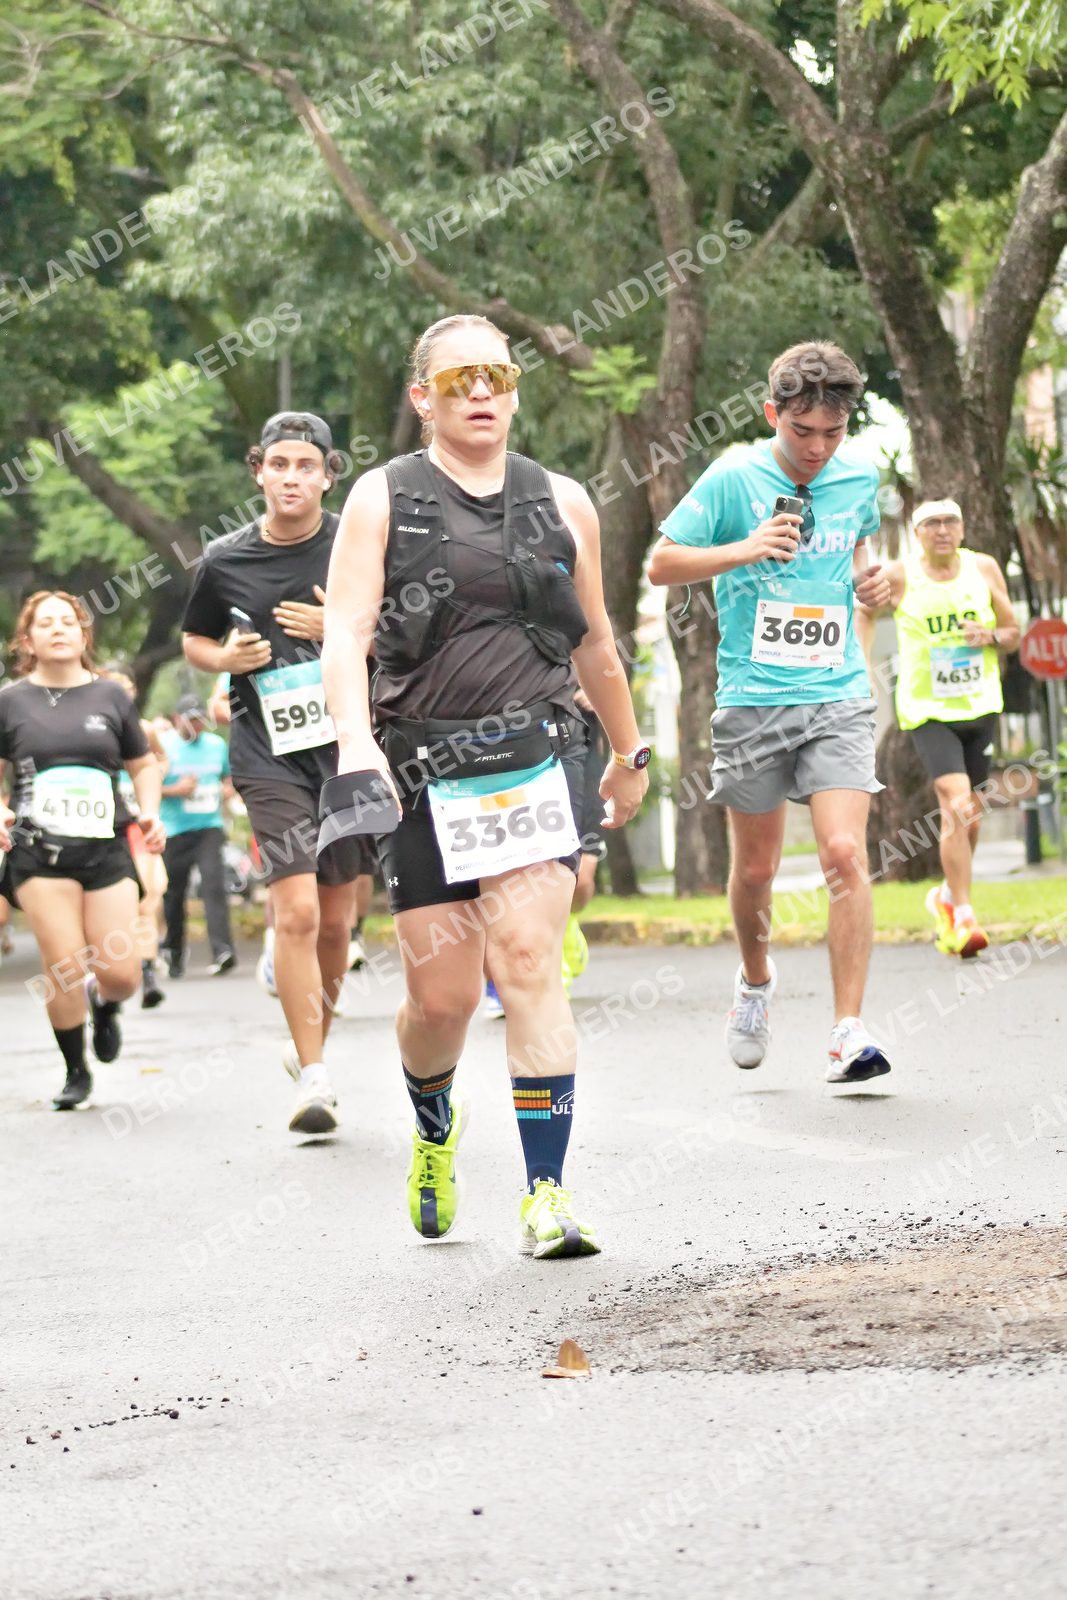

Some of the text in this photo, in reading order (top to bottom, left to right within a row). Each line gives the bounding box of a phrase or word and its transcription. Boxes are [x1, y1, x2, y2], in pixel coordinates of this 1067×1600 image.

[398, 525, 430, 535] SALOMON
[760, 616, 840, 647] 3690
[937, 666, 981, 684] 4633
[271, 700, 330, 733] 599
[42, 798, 107, 819] 4100
[446, 800, 566, 853] 3366
